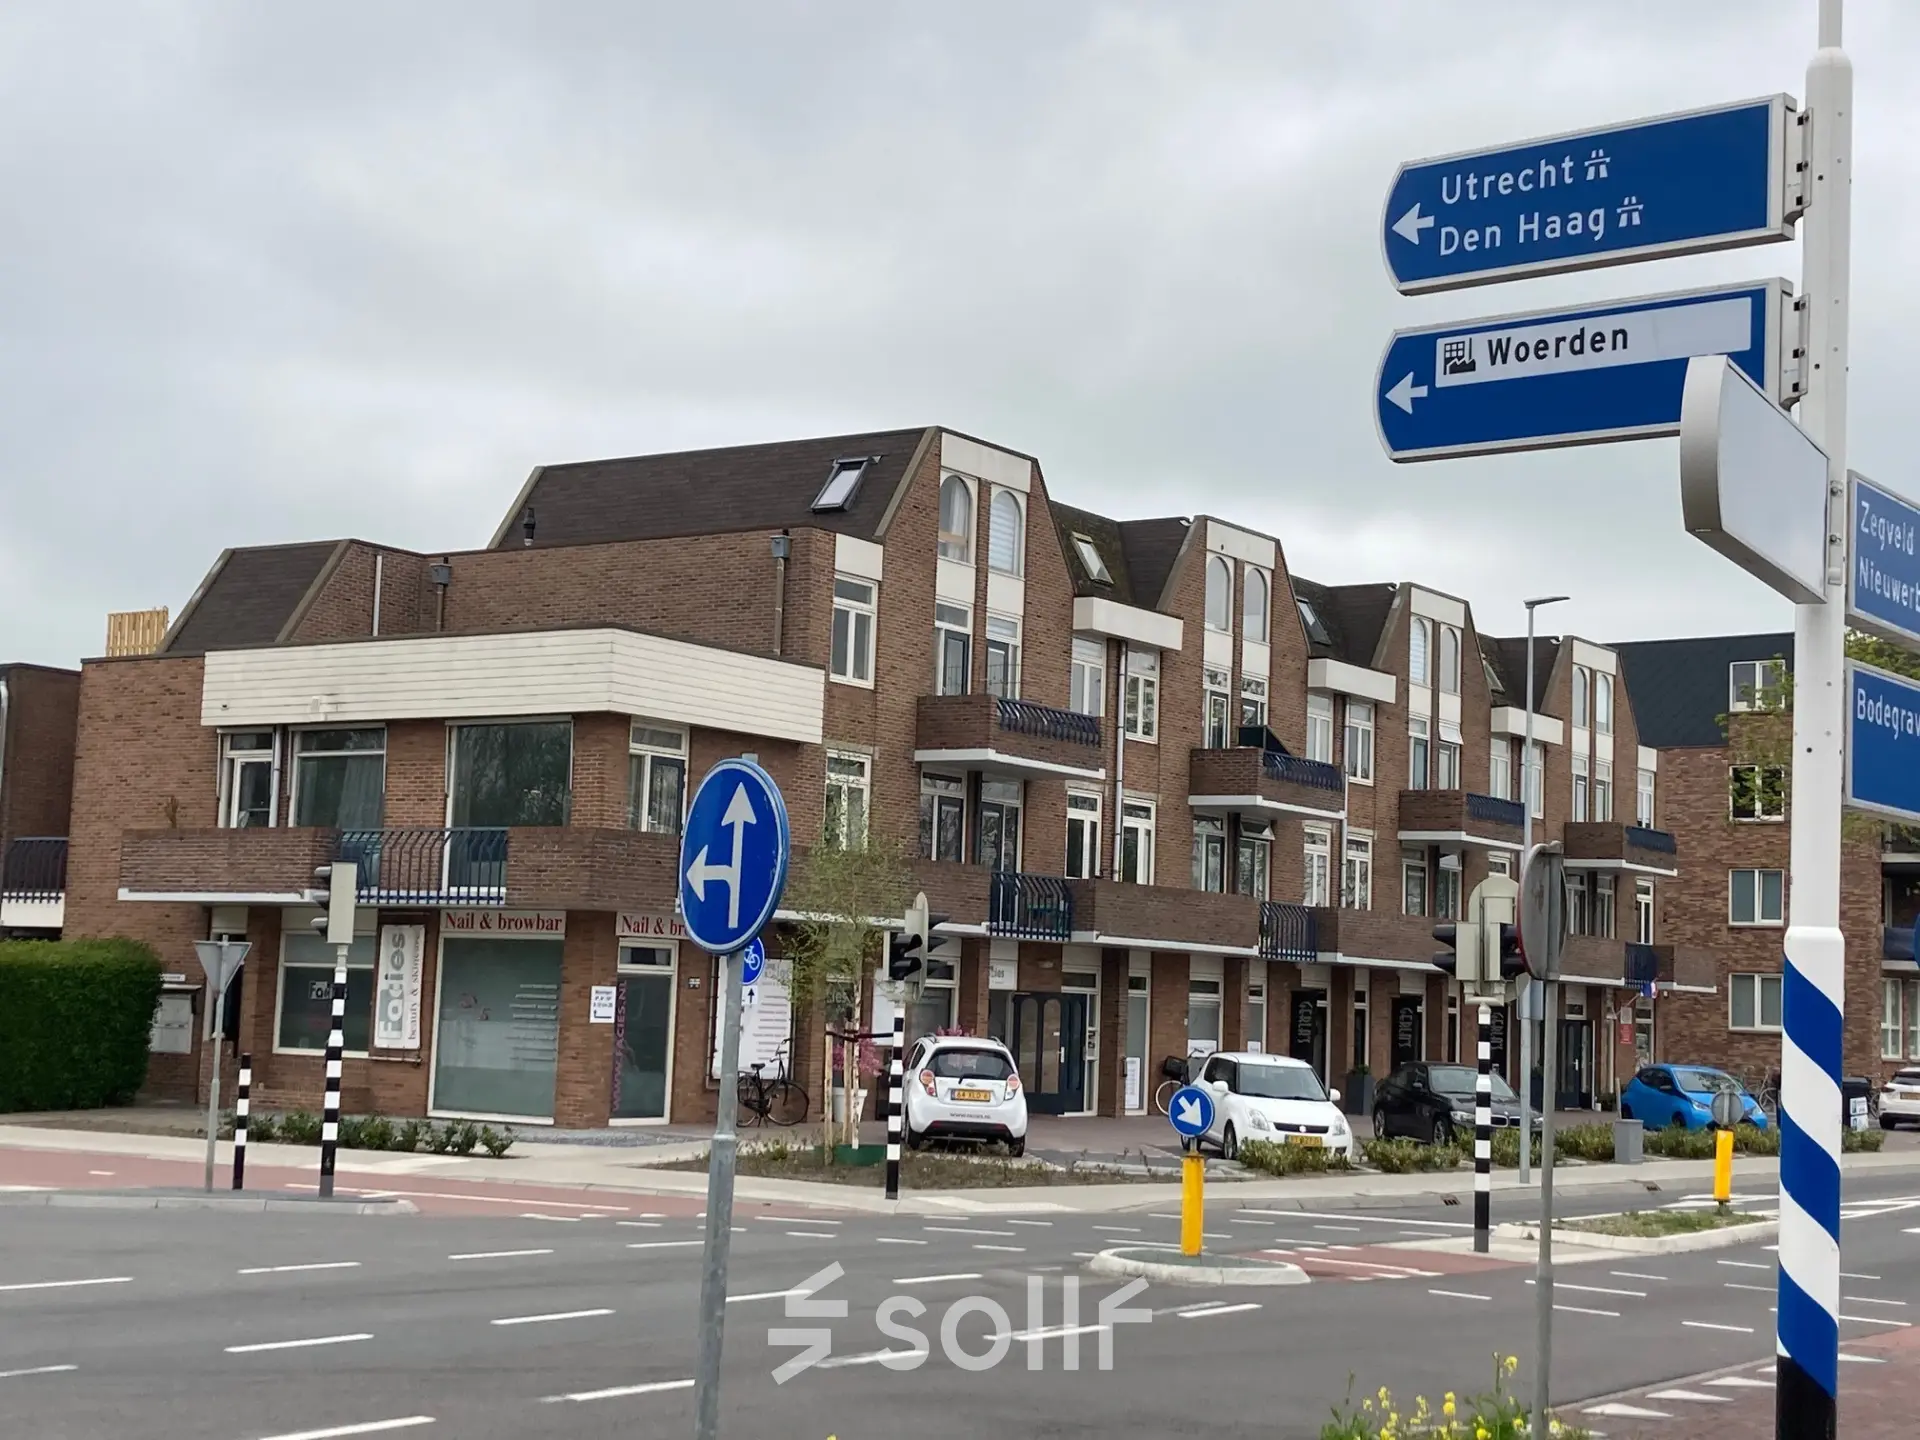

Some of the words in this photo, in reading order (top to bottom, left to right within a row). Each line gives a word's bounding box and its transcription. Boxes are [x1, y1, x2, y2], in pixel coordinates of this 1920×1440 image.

[1442, 155, 1574, 204] Utrecht
[1440, 225, 1501, 256] Den
[1518, 207, 1605, 244] Haag
[1487, 326, 1628, 367] Woerden
[1860, 500, 1915, 556] Zegveld
[445, 912, 475, 930] Nail
[480, 912, 492, 931] &
[499, 912, 563, 931] browbar
[621, 915, 649, 934] Nail
[653, 916, 665, 935] &
[378, 932, 406, 1040] Facies
